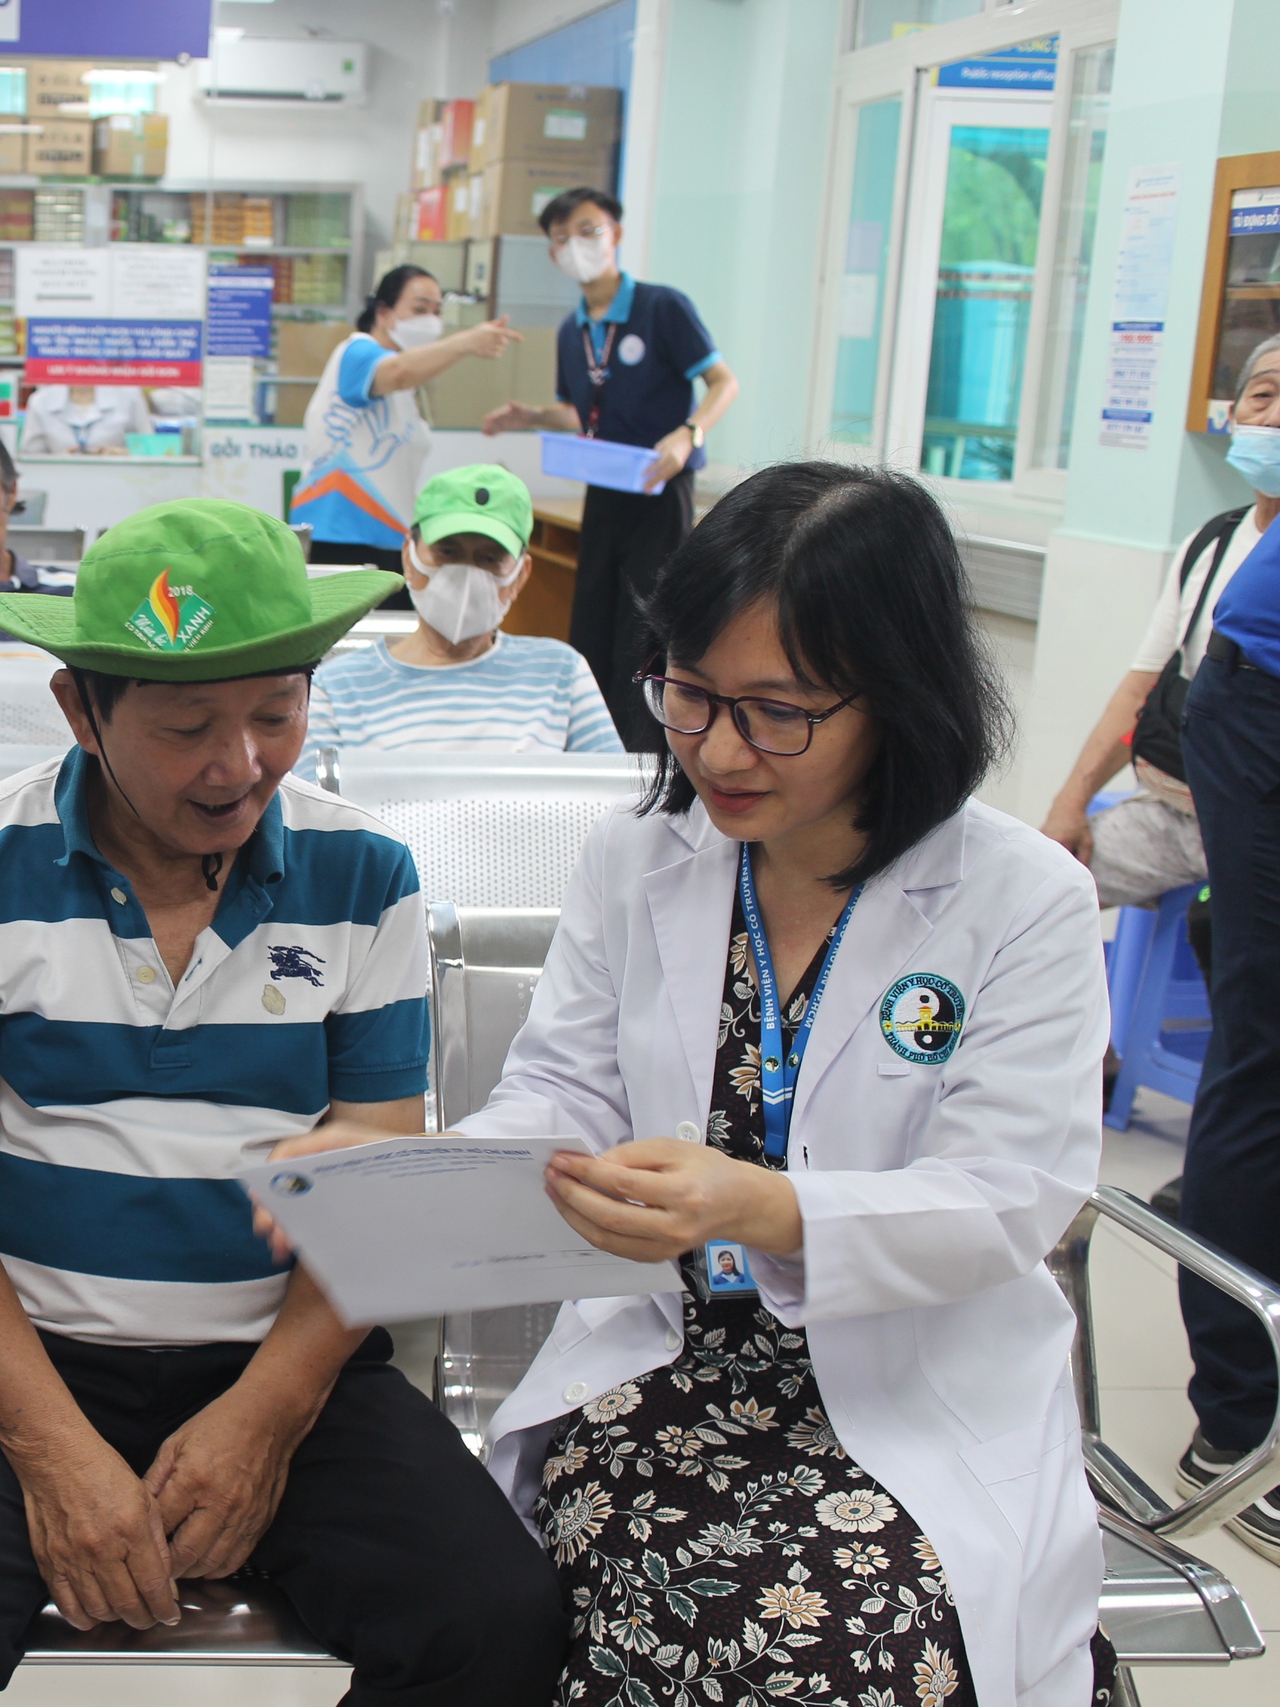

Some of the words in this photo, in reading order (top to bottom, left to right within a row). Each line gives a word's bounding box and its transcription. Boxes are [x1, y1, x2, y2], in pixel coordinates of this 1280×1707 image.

[167, 585, 193, 597] 2018
[176, 606, 211, 644] XANH
[741, 867, 754, 912] TRUYỀN
[746, 914, 759, 929] CỔ
[753, 931, 765, 957] HỌC
[759, 959, 767, 967] Y
[761, 969, 773, 997] VIỆN
[764, 999, 777, 1029] BỆNH
